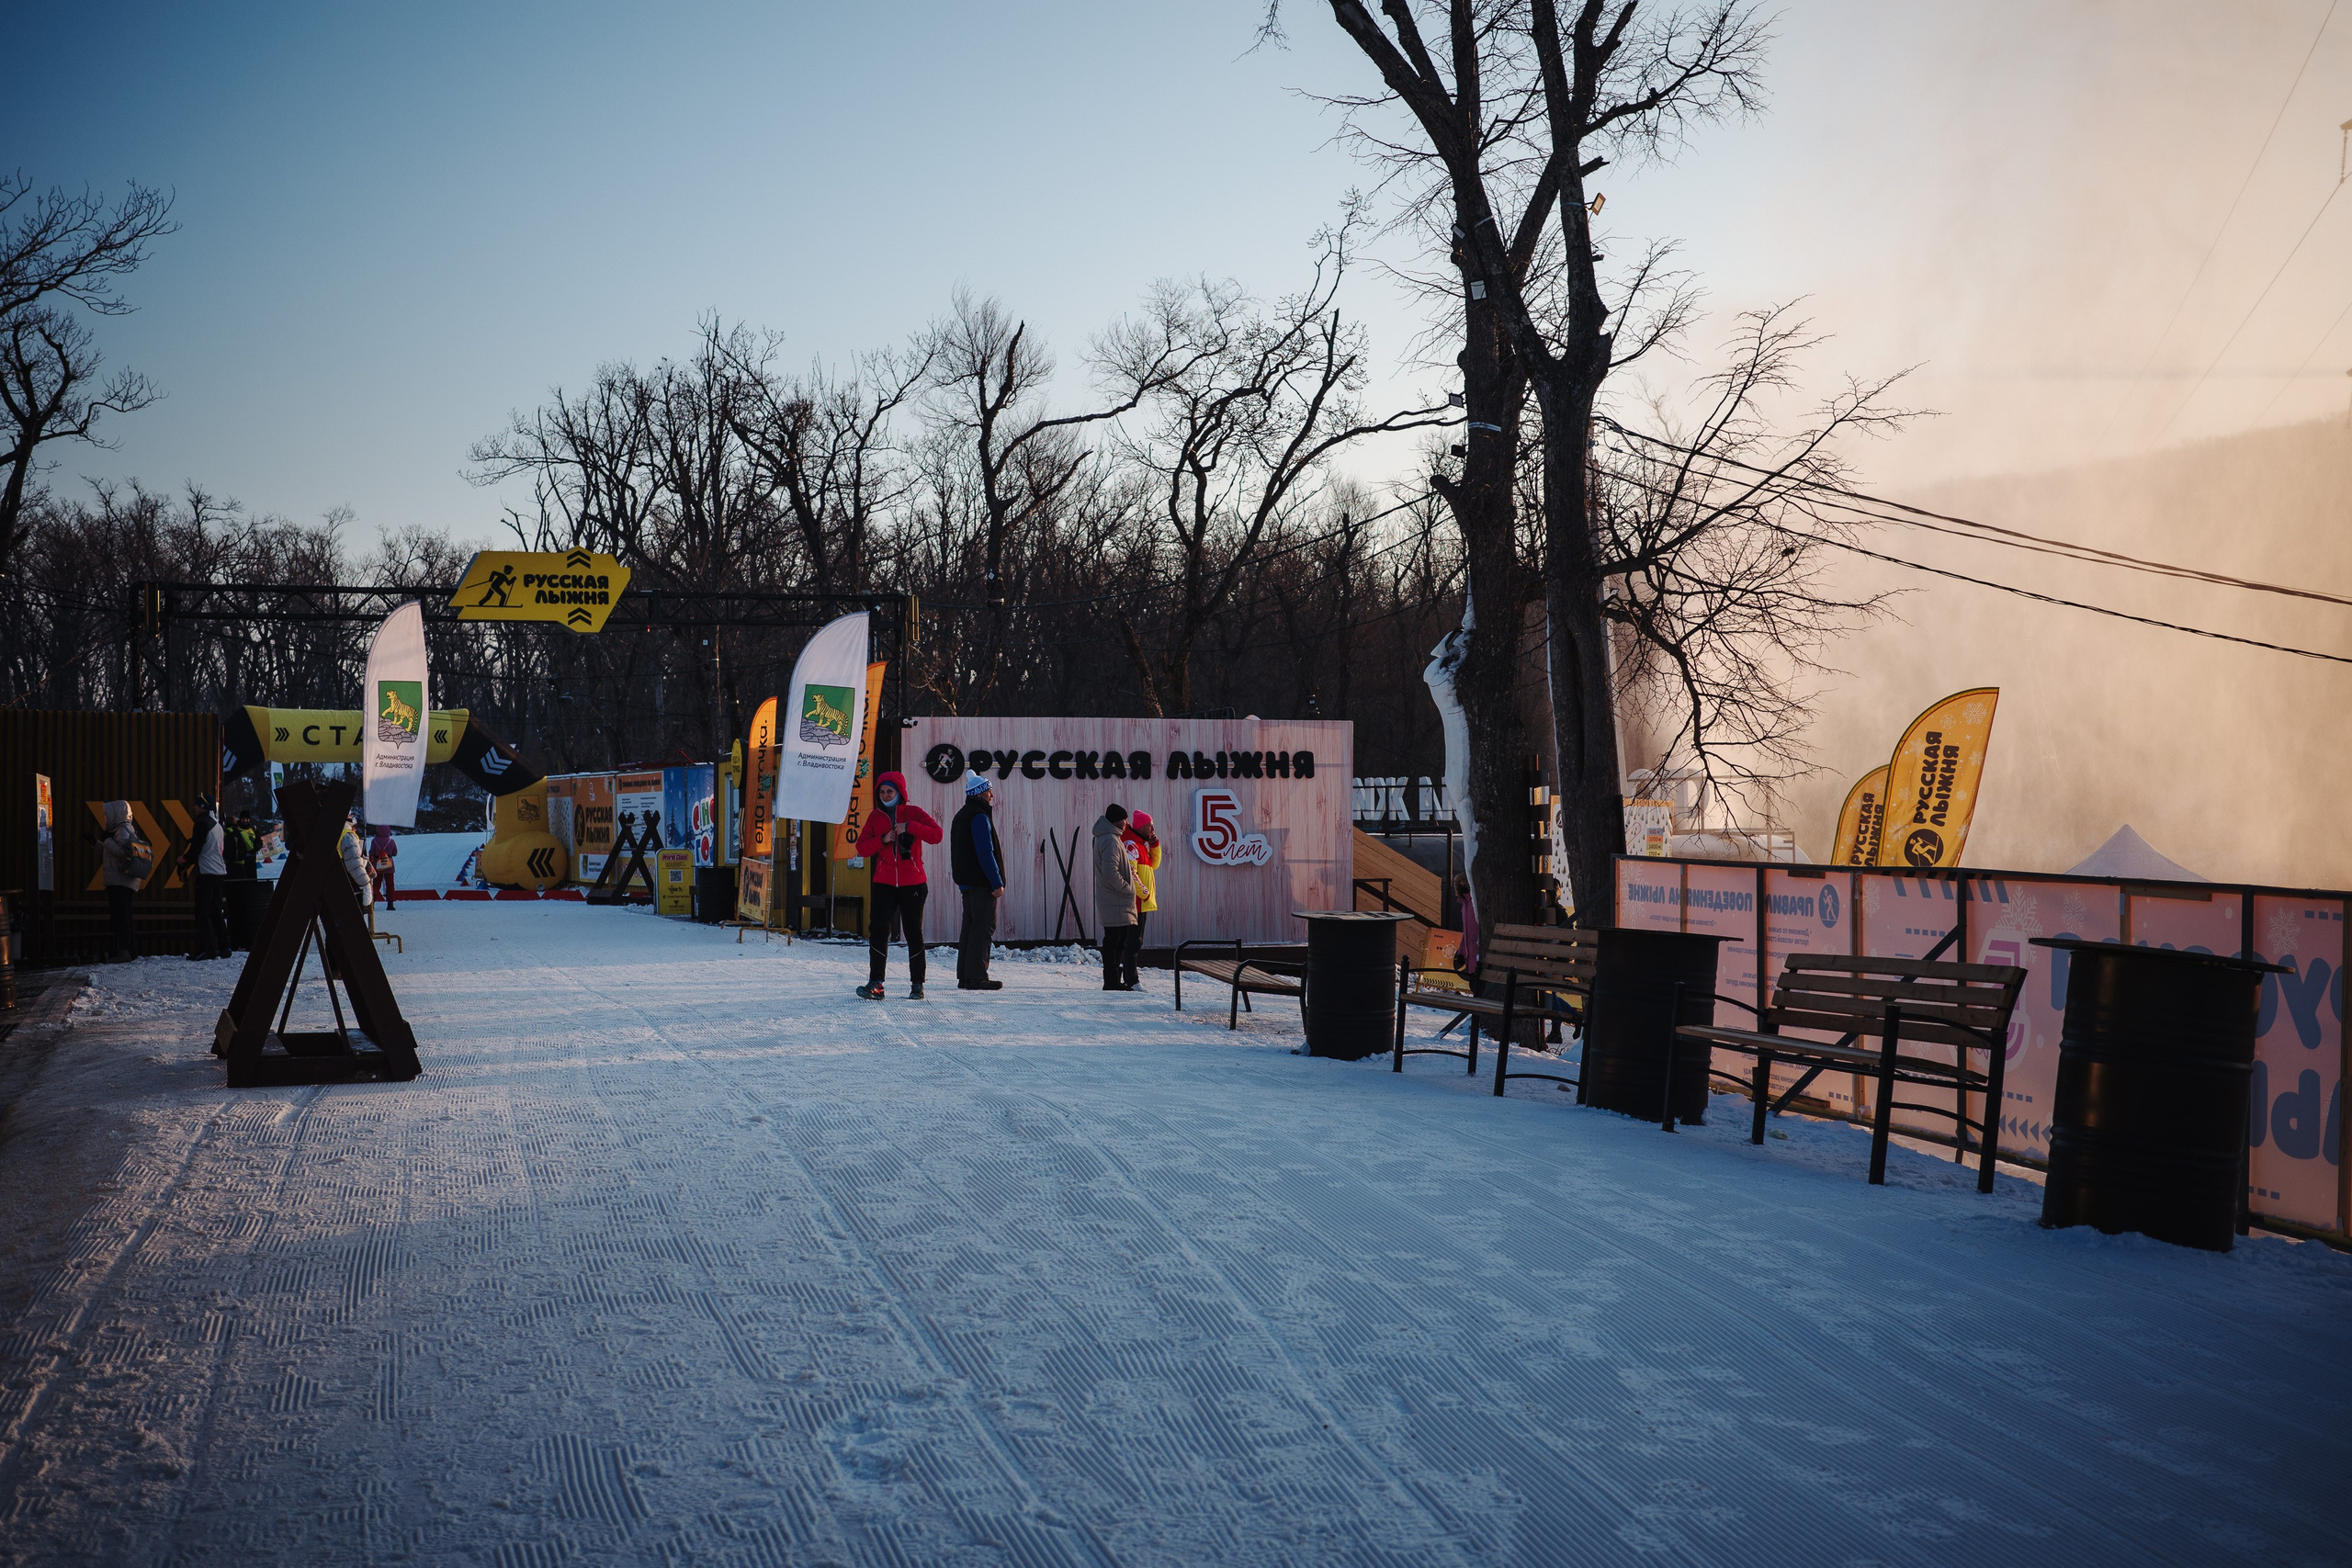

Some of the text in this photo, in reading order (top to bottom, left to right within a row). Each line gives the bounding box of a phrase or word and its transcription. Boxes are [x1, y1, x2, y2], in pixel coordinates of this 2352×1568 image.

[524, 574, 609, 589] РУССКАЯ
[535, 590, 609, 604] ЛЫЖНЯ
[302, 725, 364, 746] СТА
[376, 753, 415, 761] Администрация
[379, 761, 413, 770] Владивостока
[797, 751, 847, 763] Администрация
[802, 761, 845, 771] Владивостока
[969, 750, 1315, 780] РУССКАЯ ЛЫЖНЯ
[1913, 731, 1942, 825] РУССКАЯ
[1929, 745, 1960, 827] ЛЫЖНЯ
[586, 807, 613, 823] РУССКАЯ
[754, 805, 765, 843] еда
[846, 796, 860, 843] еда
[586, 826, 610, 843] ЛЫЖНЯ
[1198, 795, 1238, 860] 5
[1850, 793, 1875, 866] РУССКАЯ
[1222, 840, 1268, 861] лет
